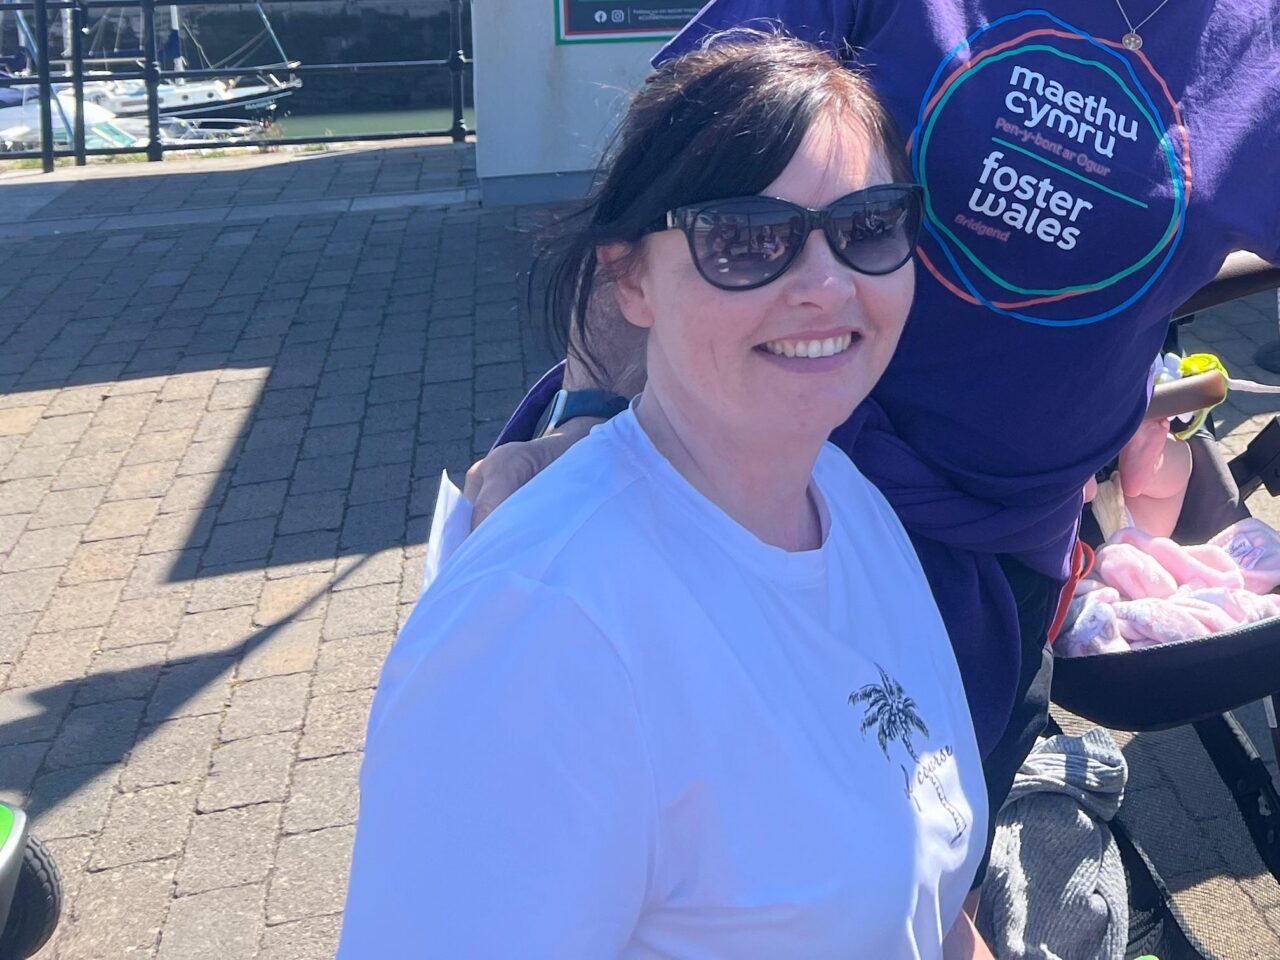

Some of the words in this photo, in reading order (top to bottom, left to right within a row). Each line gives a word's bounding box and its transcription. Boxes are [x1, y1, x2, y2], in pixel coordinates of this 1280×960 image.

[1005, 90, 1116, 159] cymru
[1009, 65, 1139, 142] maethu
[994, 116, 1063, 156] Pen-y-bont
[1062, 149, 1078, 161] ar
[1076, 153, 1111, 177] Ogwr
[968, 187, 1081, 251] wales
[978, 151, 1094, 223] foster
[954, 213, 1012, 242] Bridgend
